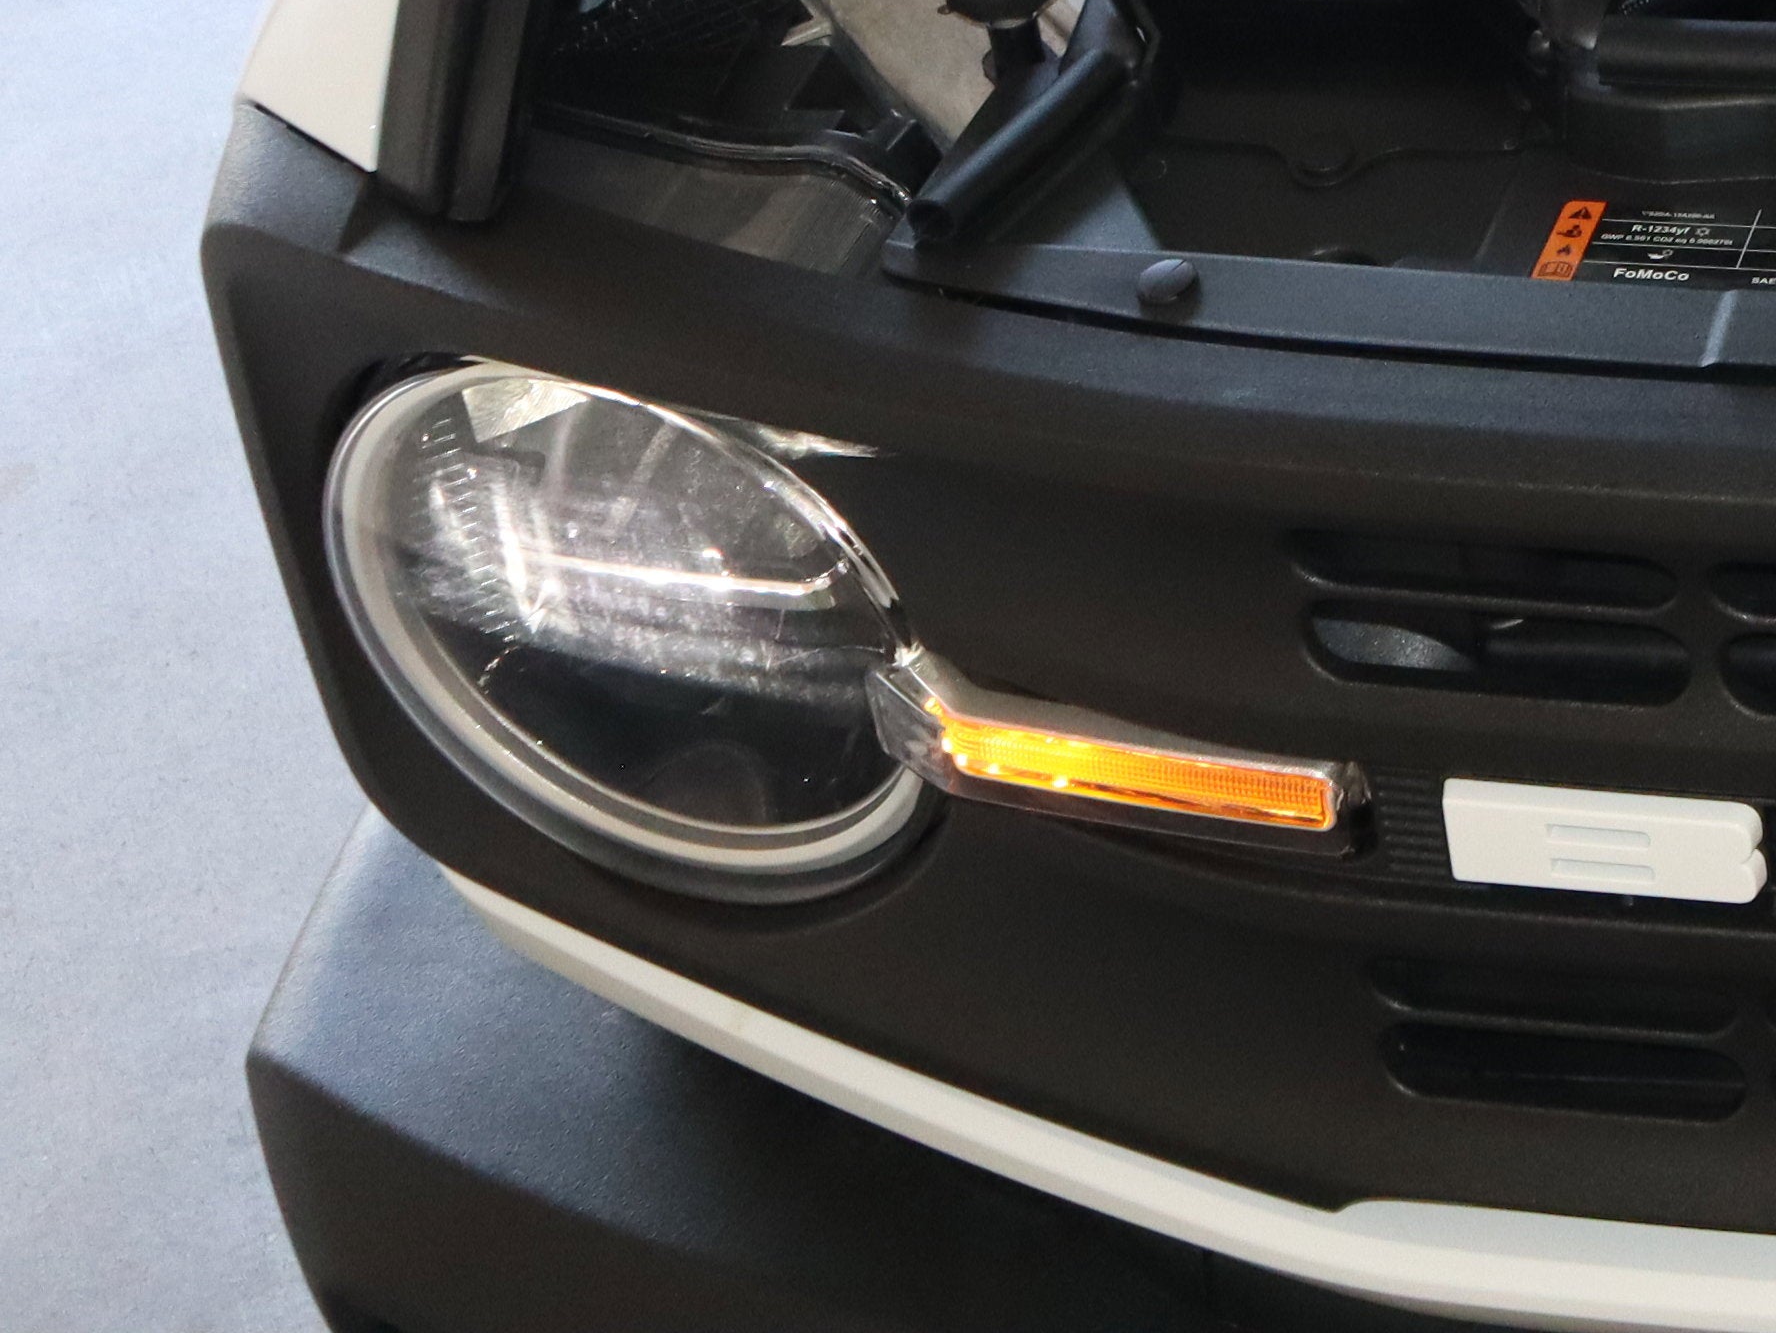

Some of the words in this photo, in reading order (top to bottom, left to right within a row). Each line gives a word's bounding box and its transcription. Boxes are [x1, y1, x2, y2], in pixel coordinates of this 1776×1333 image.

[1631, 223, 1692, 236] R-1234yf
[1613, 267, 1691, 282] FoMoCo
[1751, 276, 1776, 285] SAE
